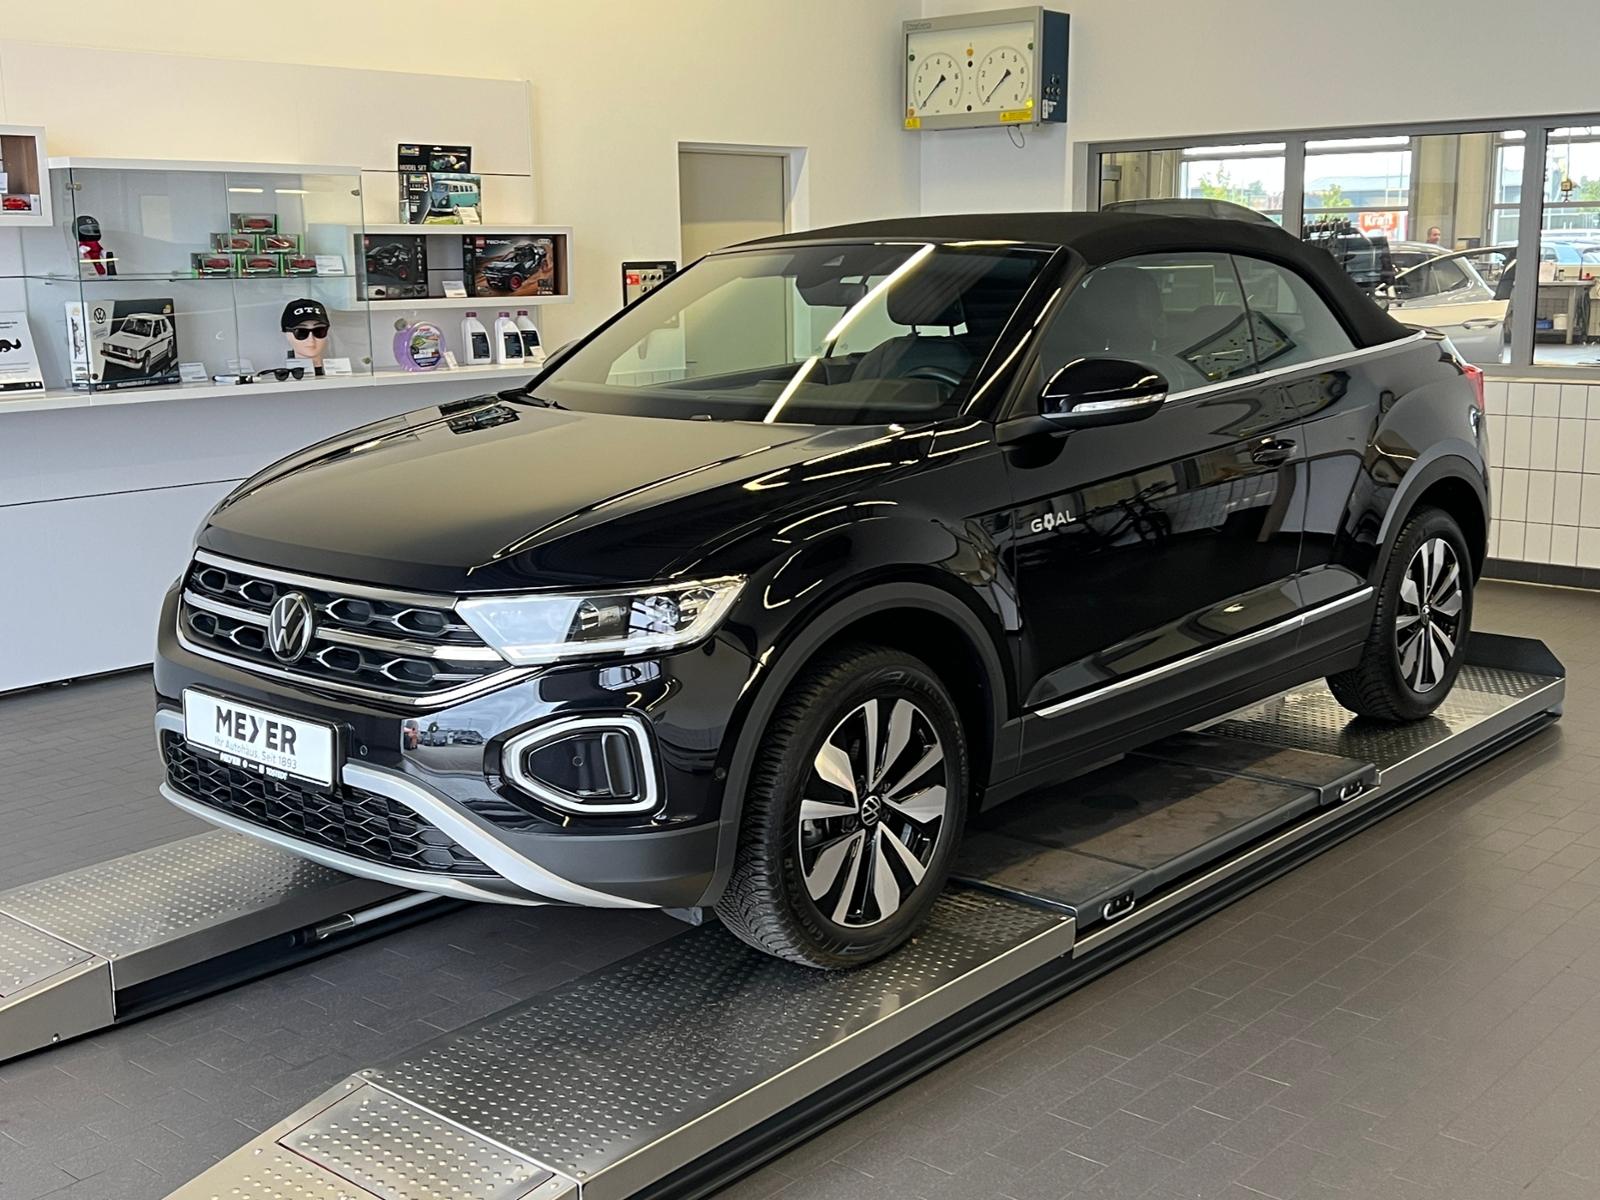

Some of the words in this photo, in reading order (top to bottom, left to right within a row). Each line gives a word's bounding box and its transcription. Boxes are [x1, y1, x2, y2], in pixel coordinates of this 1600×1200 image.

[293, 306, 321, 316] GTI
[1030, 510, 1077, 533] GOAL
[216, 705, 297, 756] MEYER
[261, 750, 277, 765] Seit
[278, 755, 298, 770] 1893
